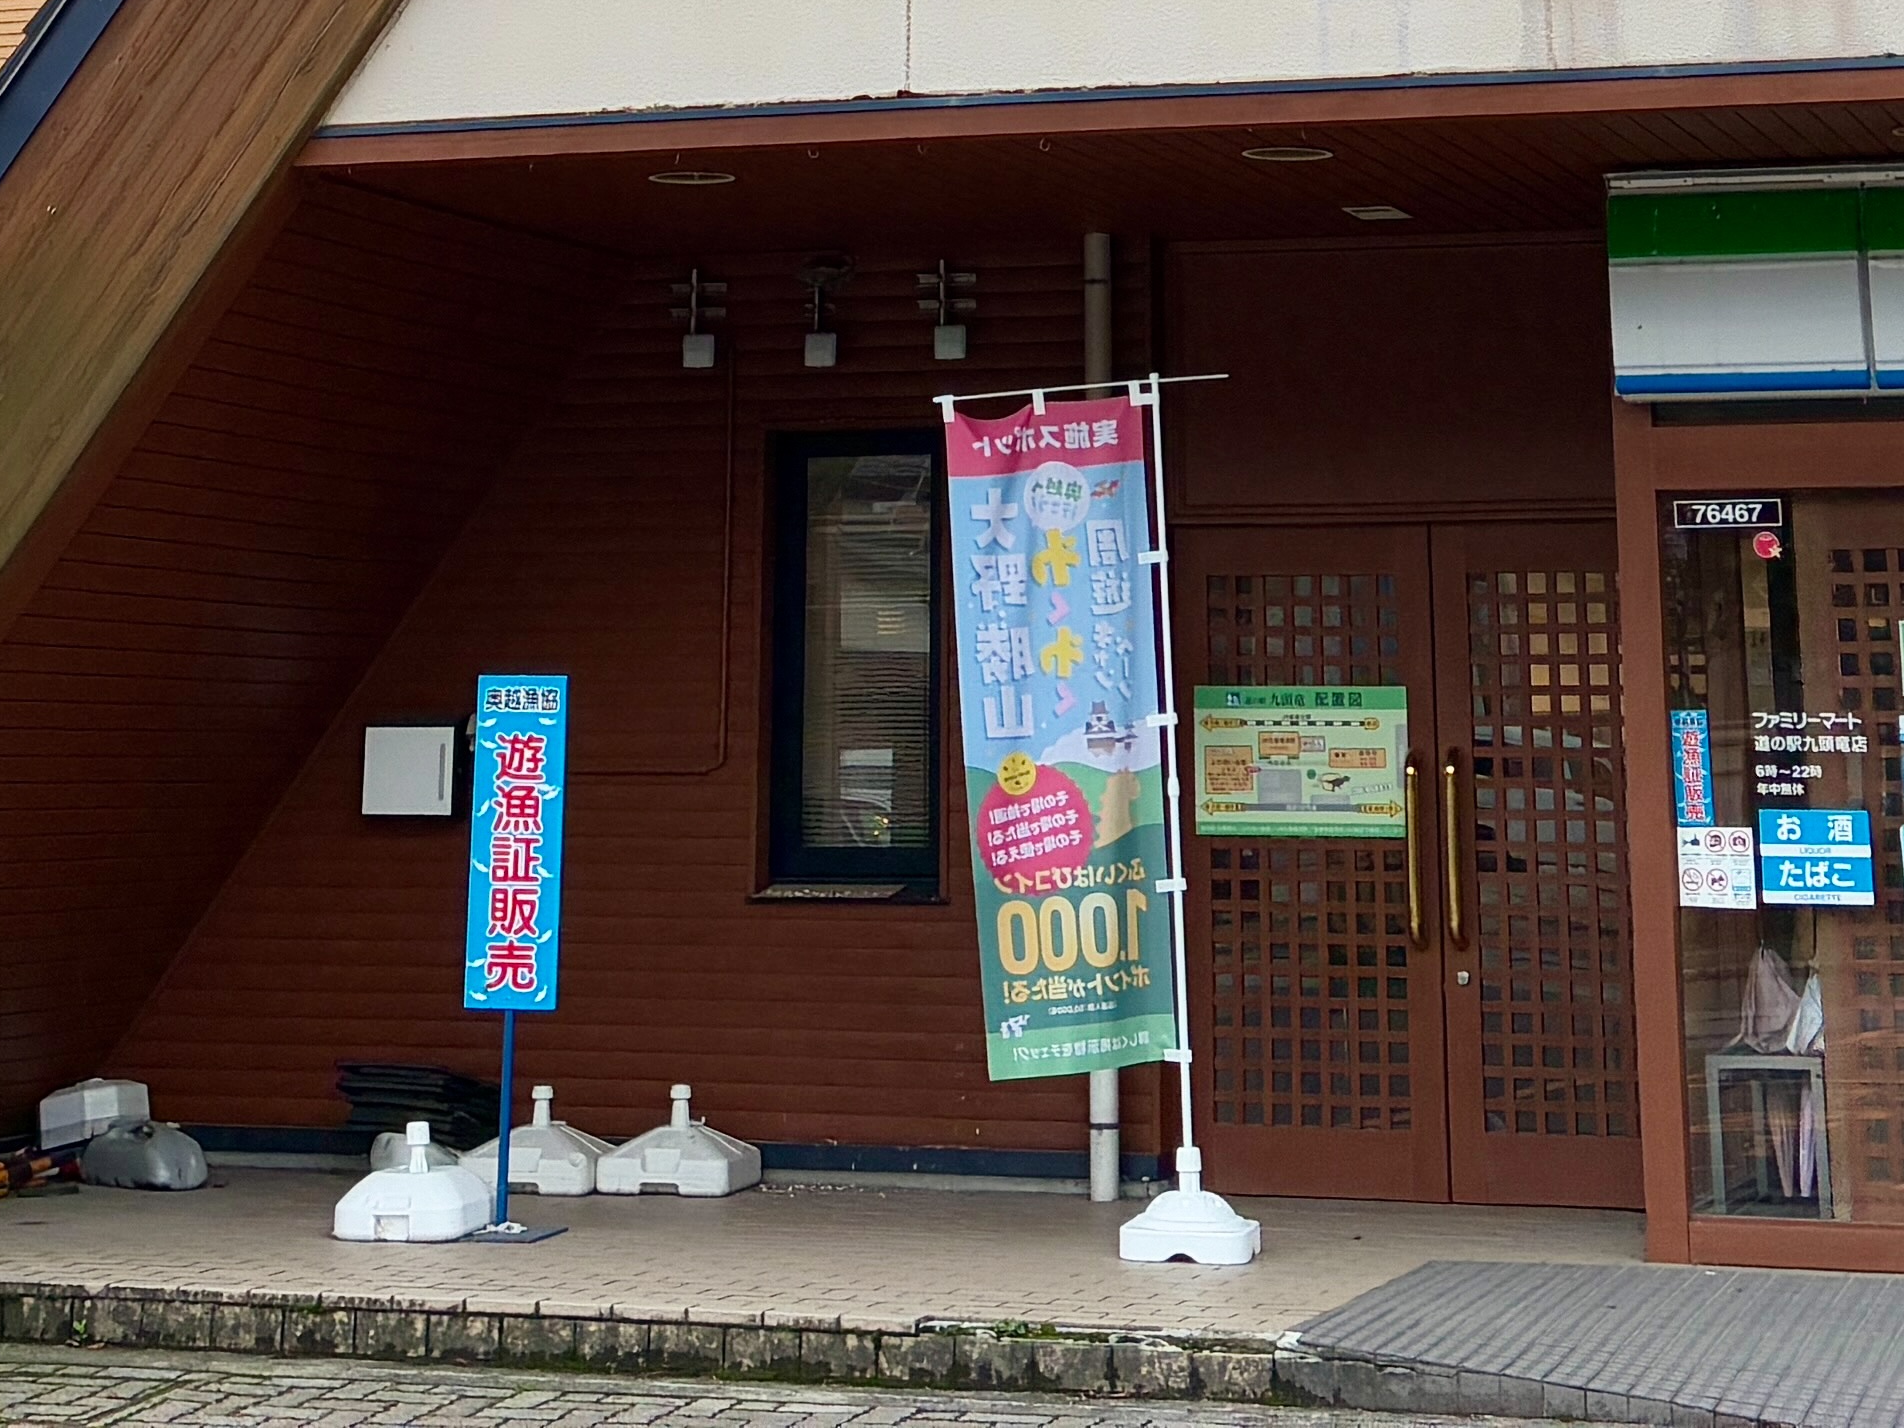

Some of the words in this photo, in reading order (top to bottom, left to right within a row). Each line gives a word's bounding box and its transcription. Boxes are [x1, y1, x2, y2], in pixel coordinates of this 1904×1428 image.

[1692, 504, 1763, 524] 76467
[484, 686, 560, 713] 奥越漁協
[1752, 711, 1863, 731] ファミリーマート
[1754, 735, 1868, 753] 道の駅九頭竜店
[484, 731, 548, 993] 遊漁証販売
[1779, 859, 1856, 888] たばこ
